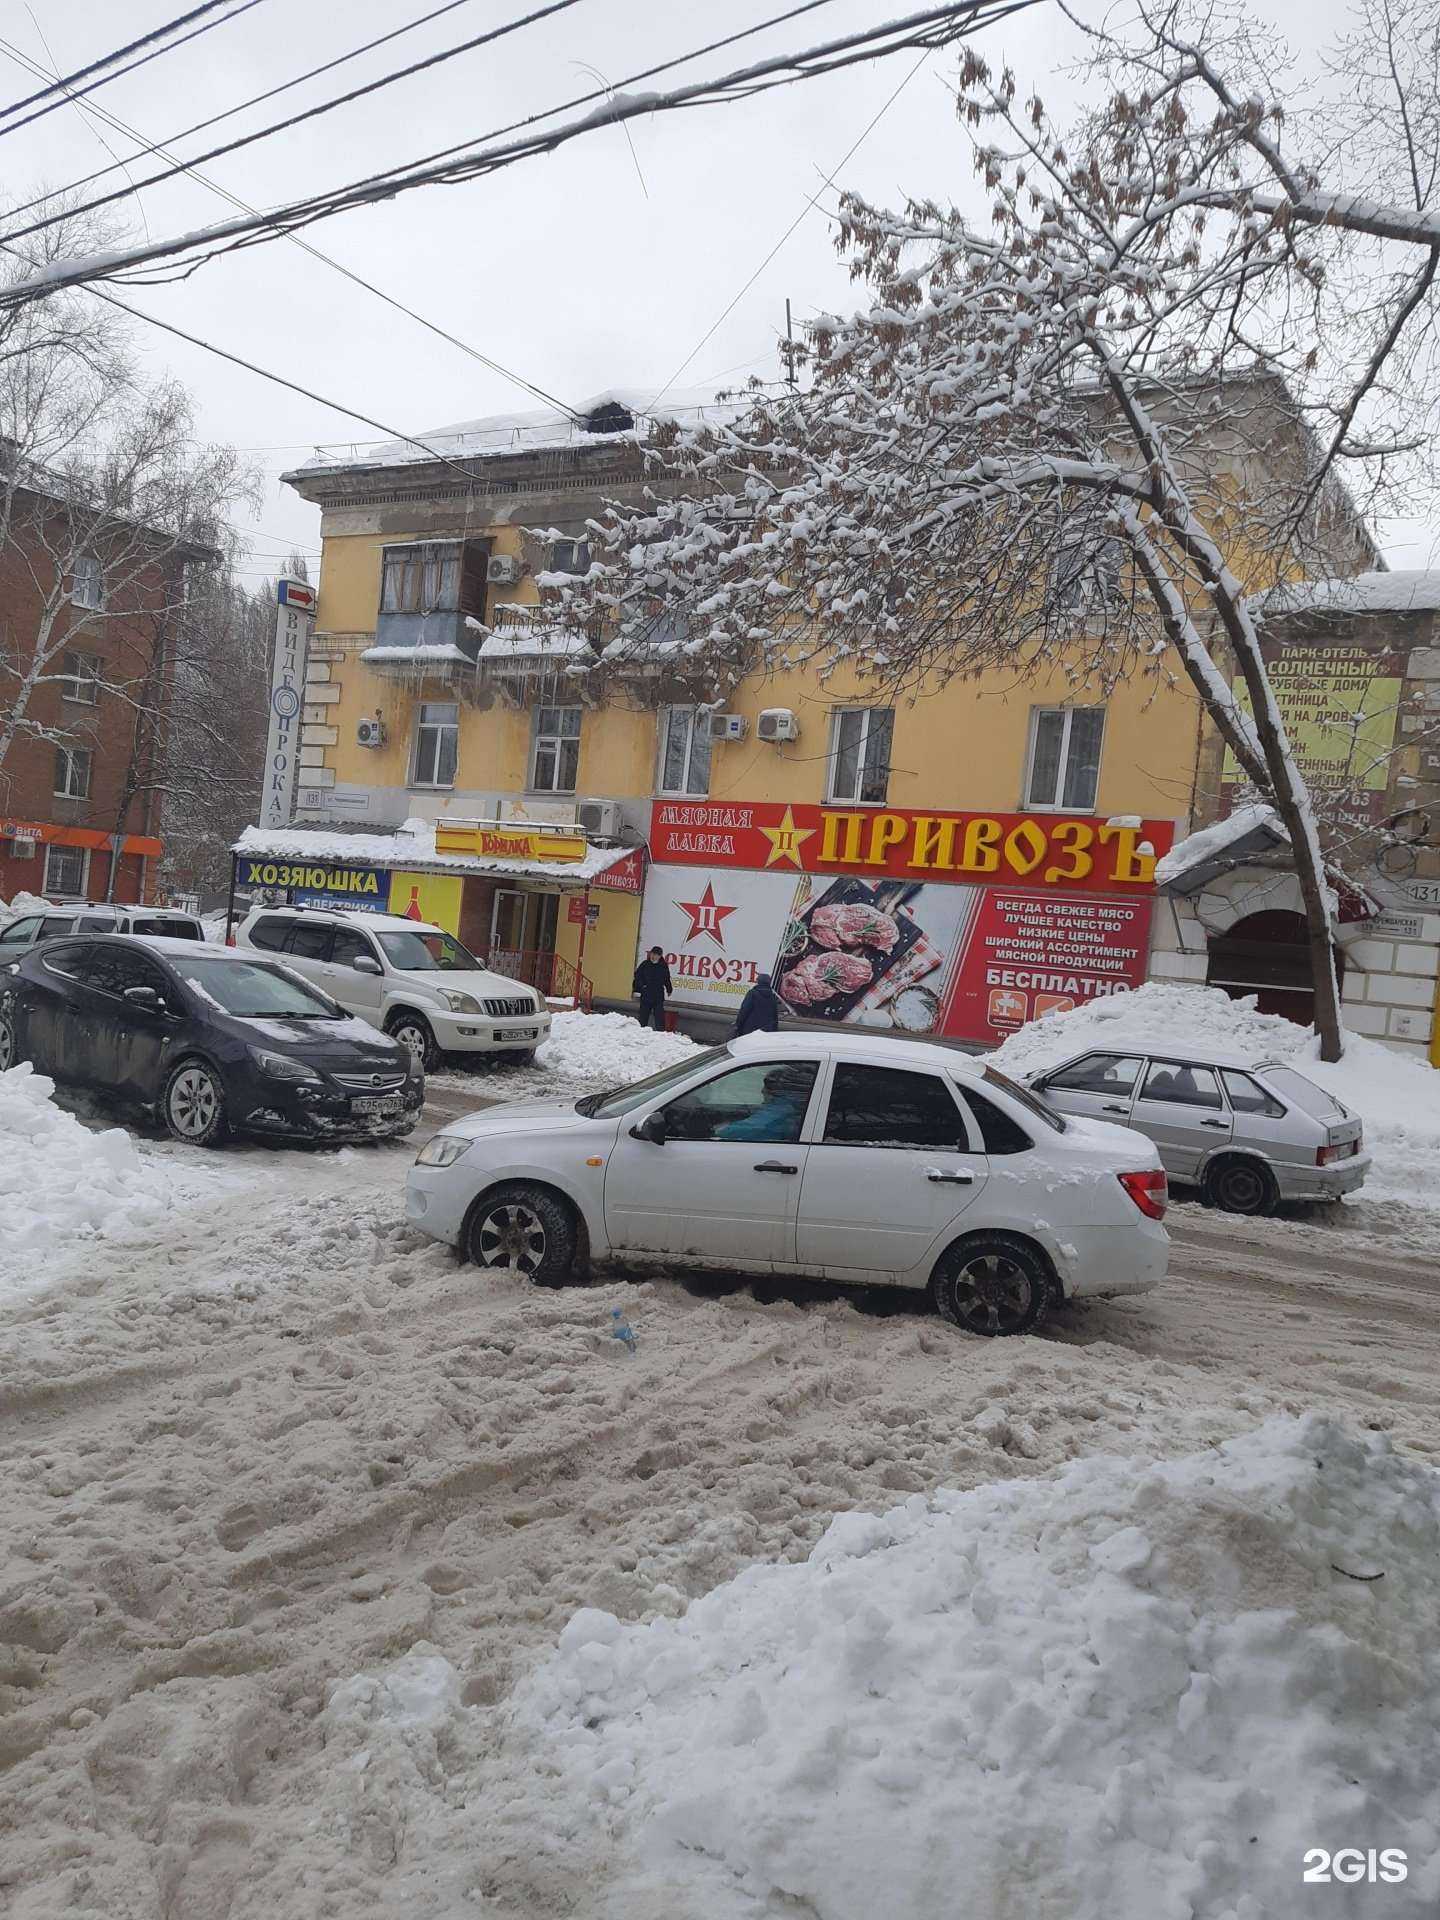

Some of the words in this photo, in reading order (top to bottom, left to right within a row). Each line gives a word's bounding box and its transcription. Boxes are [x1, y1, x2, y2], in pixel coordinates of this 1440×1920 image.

[1281, 647, 1368, 659] ПАРК-ОТЕЛЬ
[1268, 678, 1329, 691] РУБОВЫЕ
[1332, 678, 1369, 692] ДОМА
[659, 805, 753, 829] МЯСНАЯ
[667, 832, 735, 855] ЛАВКА
[778, 831, 793, 850] П
[816, 810, 1158, 883] ПРИВОЗЪ
[248, 863, 379, 894] ХОЗЯЮШКА
[600, 874, 638, 889] ПРИВОЗЪ
[696, 905, 718, 930] П
[996, 901, 1042, 914] ВСЕГДА
[1045, 904, 1095, 917] СВЕЖЕЕ
[1098, 908, 1134, 920] МЯСО
[1004, 914, 1054, 927] ЛУЧШЕЕ
[1056, 918, 1122, 931] КАЧЕСТВО
[1018, 927, 1065, 940] НИЗКИЕ
[1068, 930, 1105, 943] ЦЕНЫ
[985, 936, 1044, 950] ШИРОКИЙ
[1046, 942, 1138, 959] АССОРТИМЕНТ
[646, 950, 760, 984] РИВОЗЪ
[995, 949, 1046, 963] МЯСНОЙ
[1049, 954, 1124, 971] ПРОДУКЦИИ
[986, 968, 1130, 997] БЕСПЛАТНО
